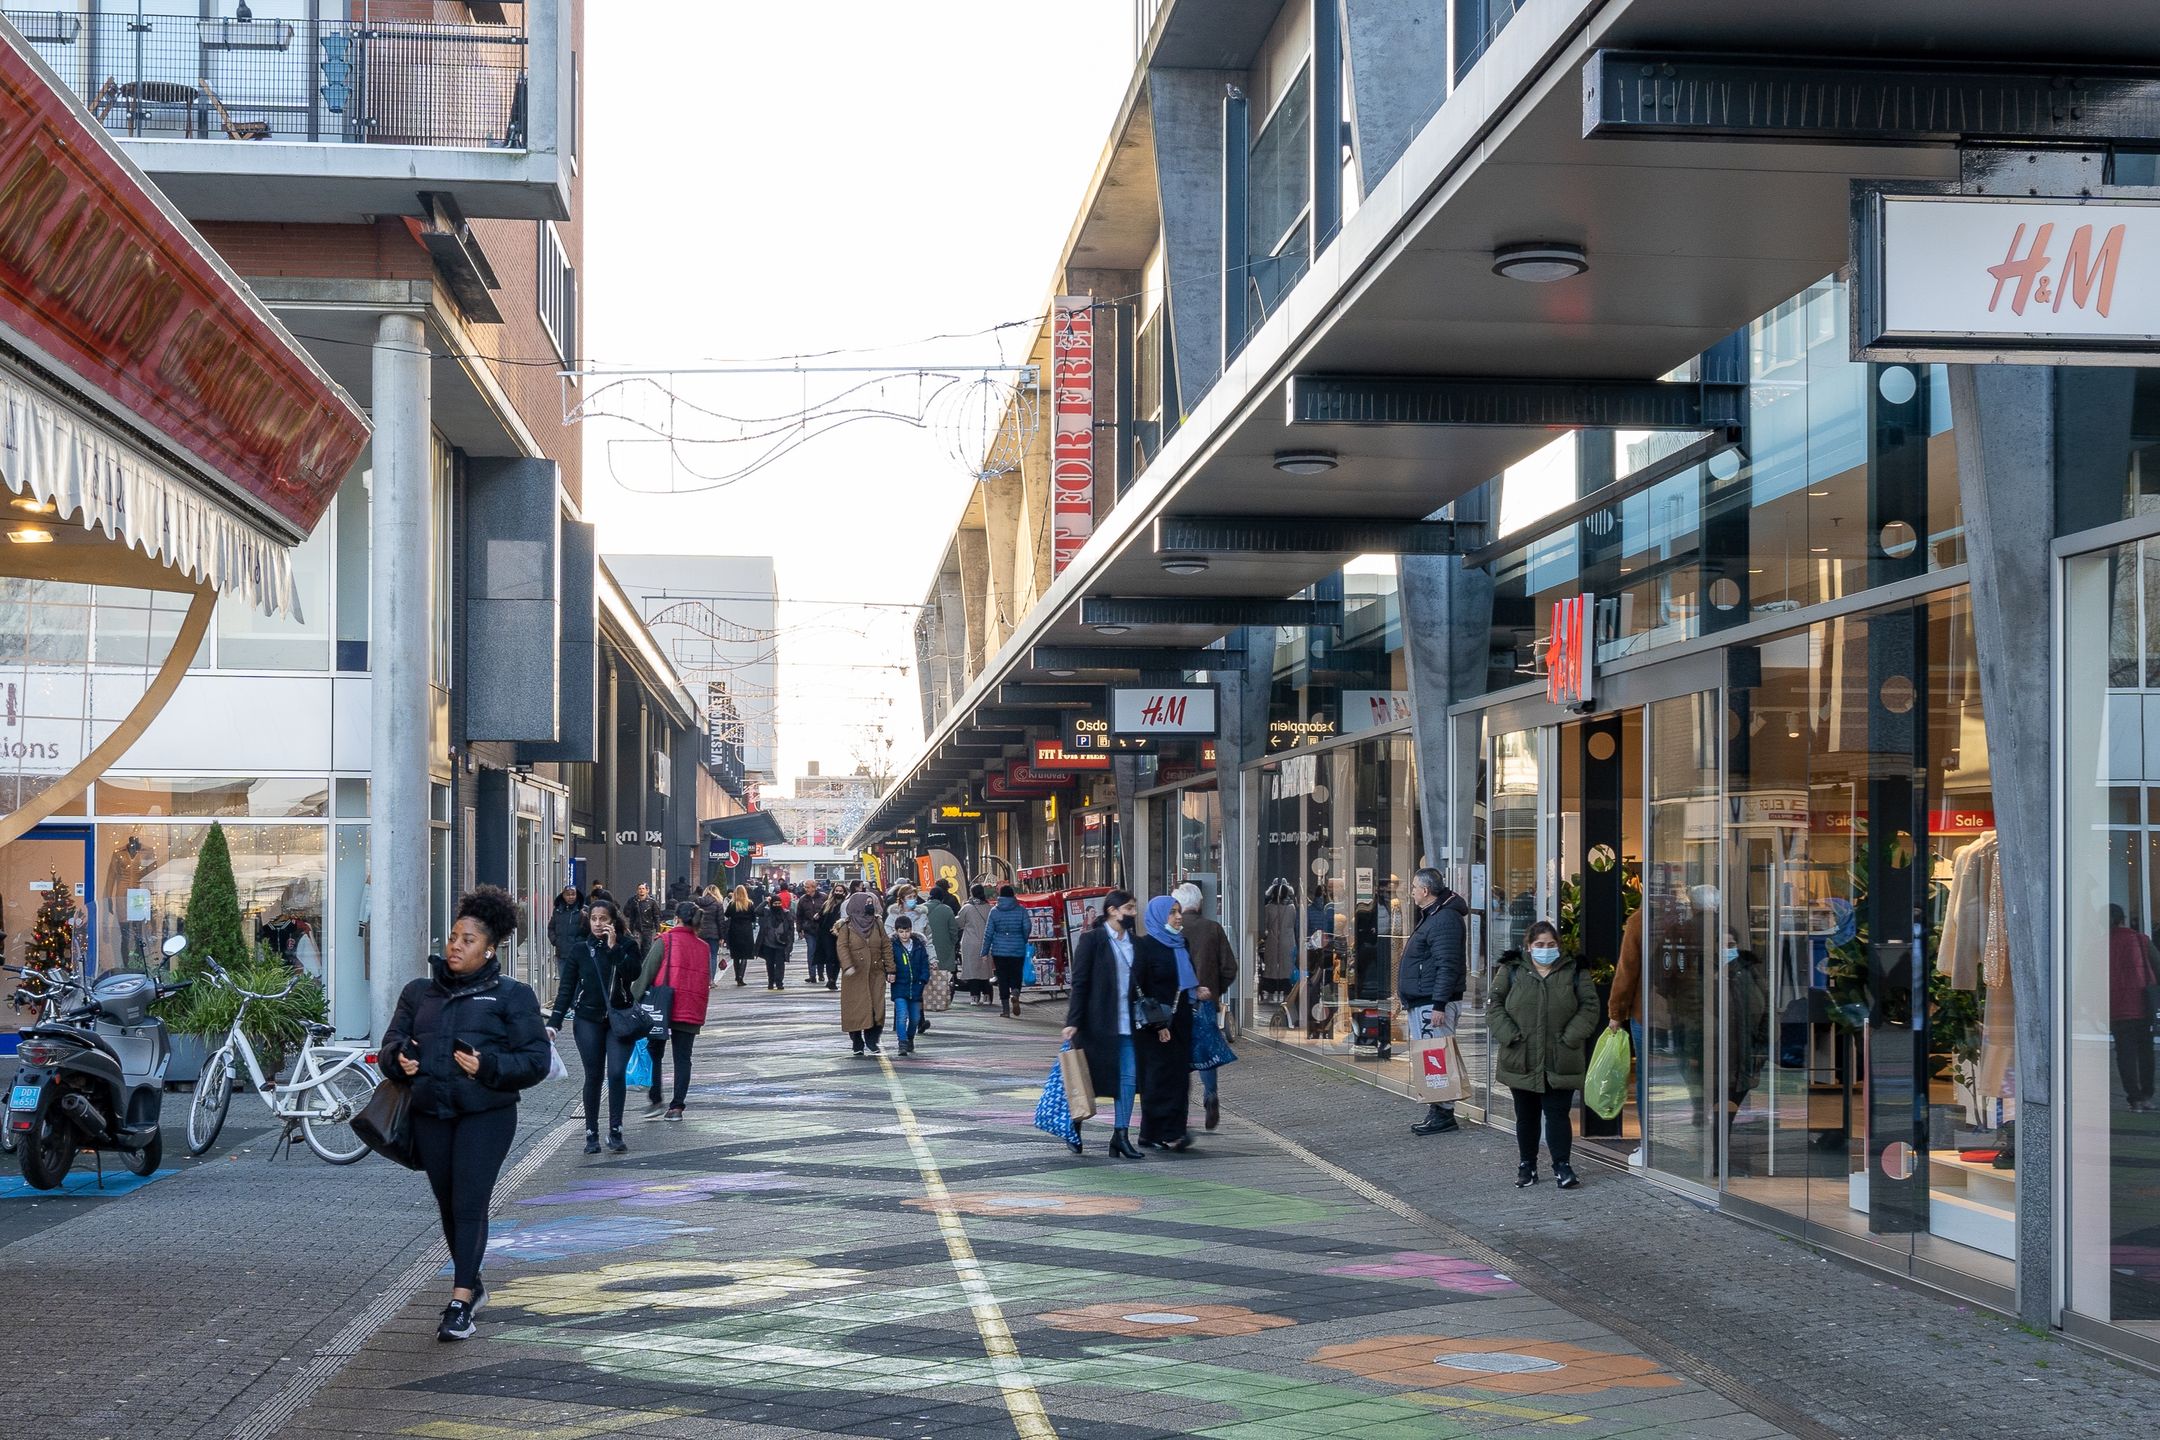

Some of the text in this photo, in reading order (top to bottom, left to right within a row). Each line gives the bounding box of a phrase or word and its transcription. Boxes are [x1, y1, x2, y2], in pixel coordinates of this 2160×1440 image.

[1987, 223, 2126, 318] H&M
[1055, 429, 1092, 515] FOR
[1141, 695, 1187, 726] H&M
[1039, 749, 1056, 760] FIT
[1826, 814, 1854, 827] Sale
[1955, 814, 1983, 827] Sale
